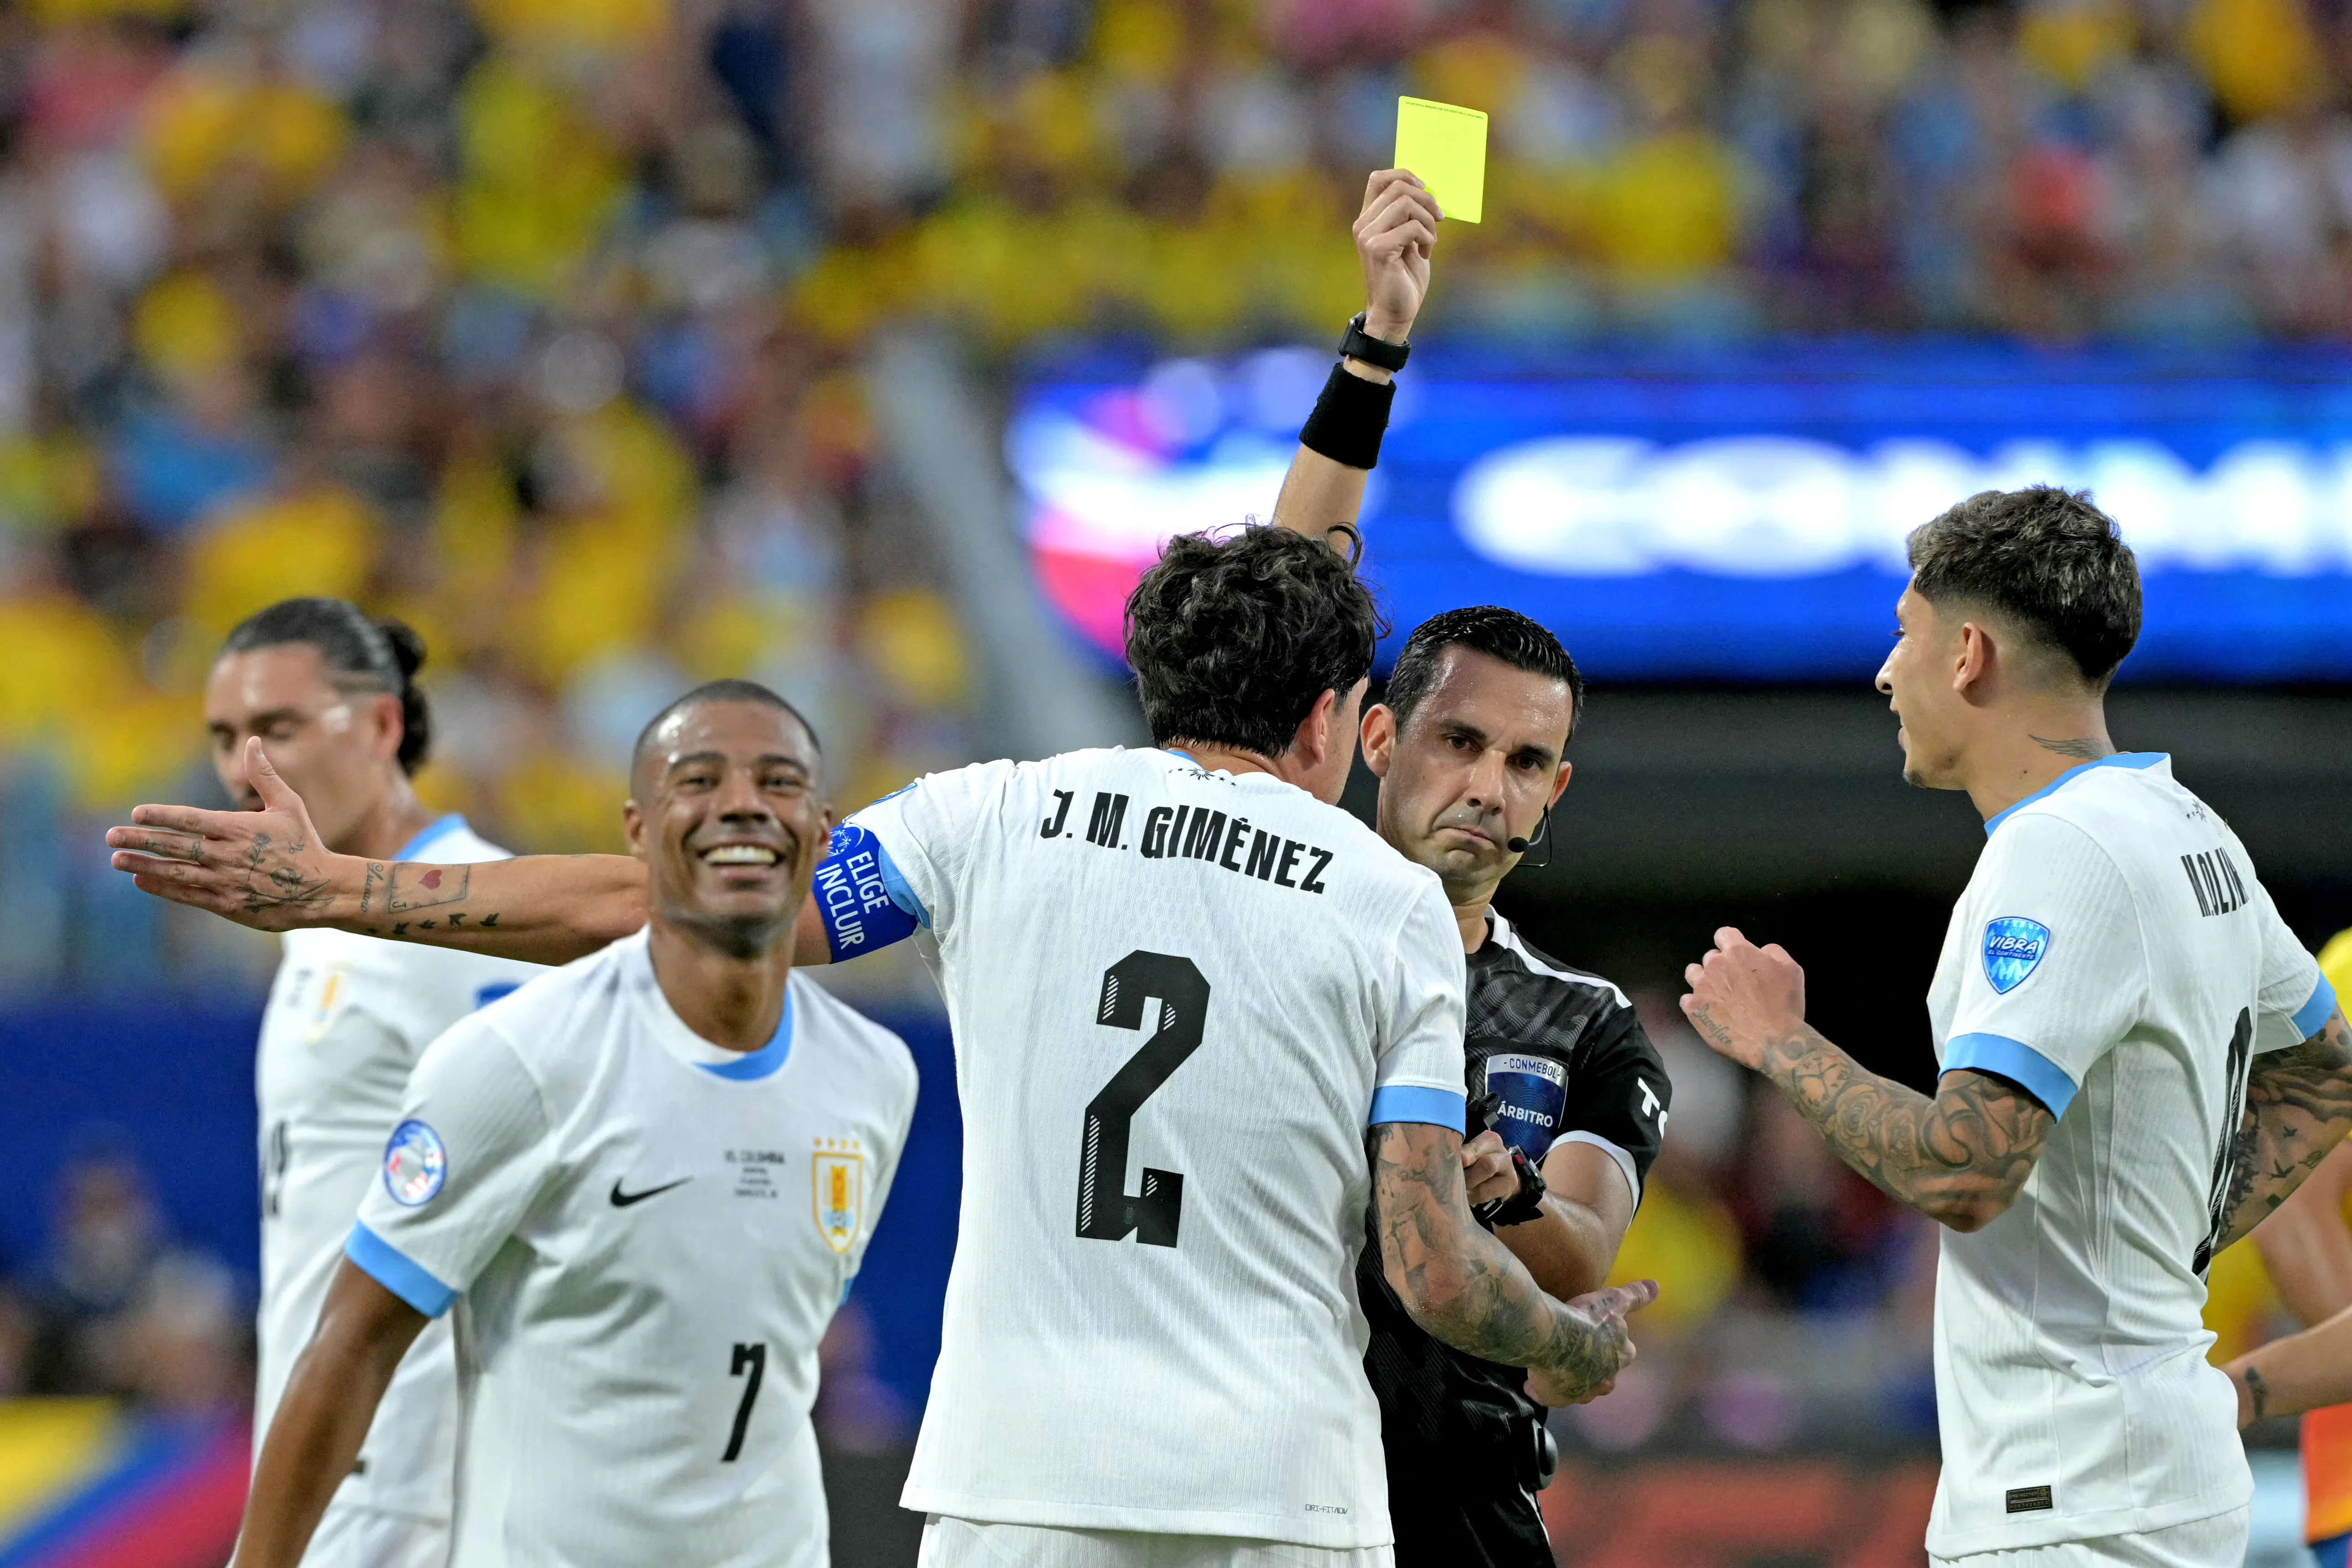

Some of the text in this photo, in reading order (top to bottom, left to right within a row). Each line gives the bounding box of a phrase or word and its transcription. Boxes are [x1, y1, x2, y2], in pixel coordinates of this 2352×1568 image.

[1040, 789, 1333, 894] J. M. GIMÉNEZ
[815, 863, 865, 950] INCLUIR
[846, 851, 889, 914] ELIGE
[1989, 935, 2038, 953] VIBRA
[1076, 949, 1211, 1248] 2
[1510, 1058, 1556, 1079] CONMEBOL
[1497, 1100, 1553, 1127] ÁRBITRO
[720, 1343, 767, 1463] 7
